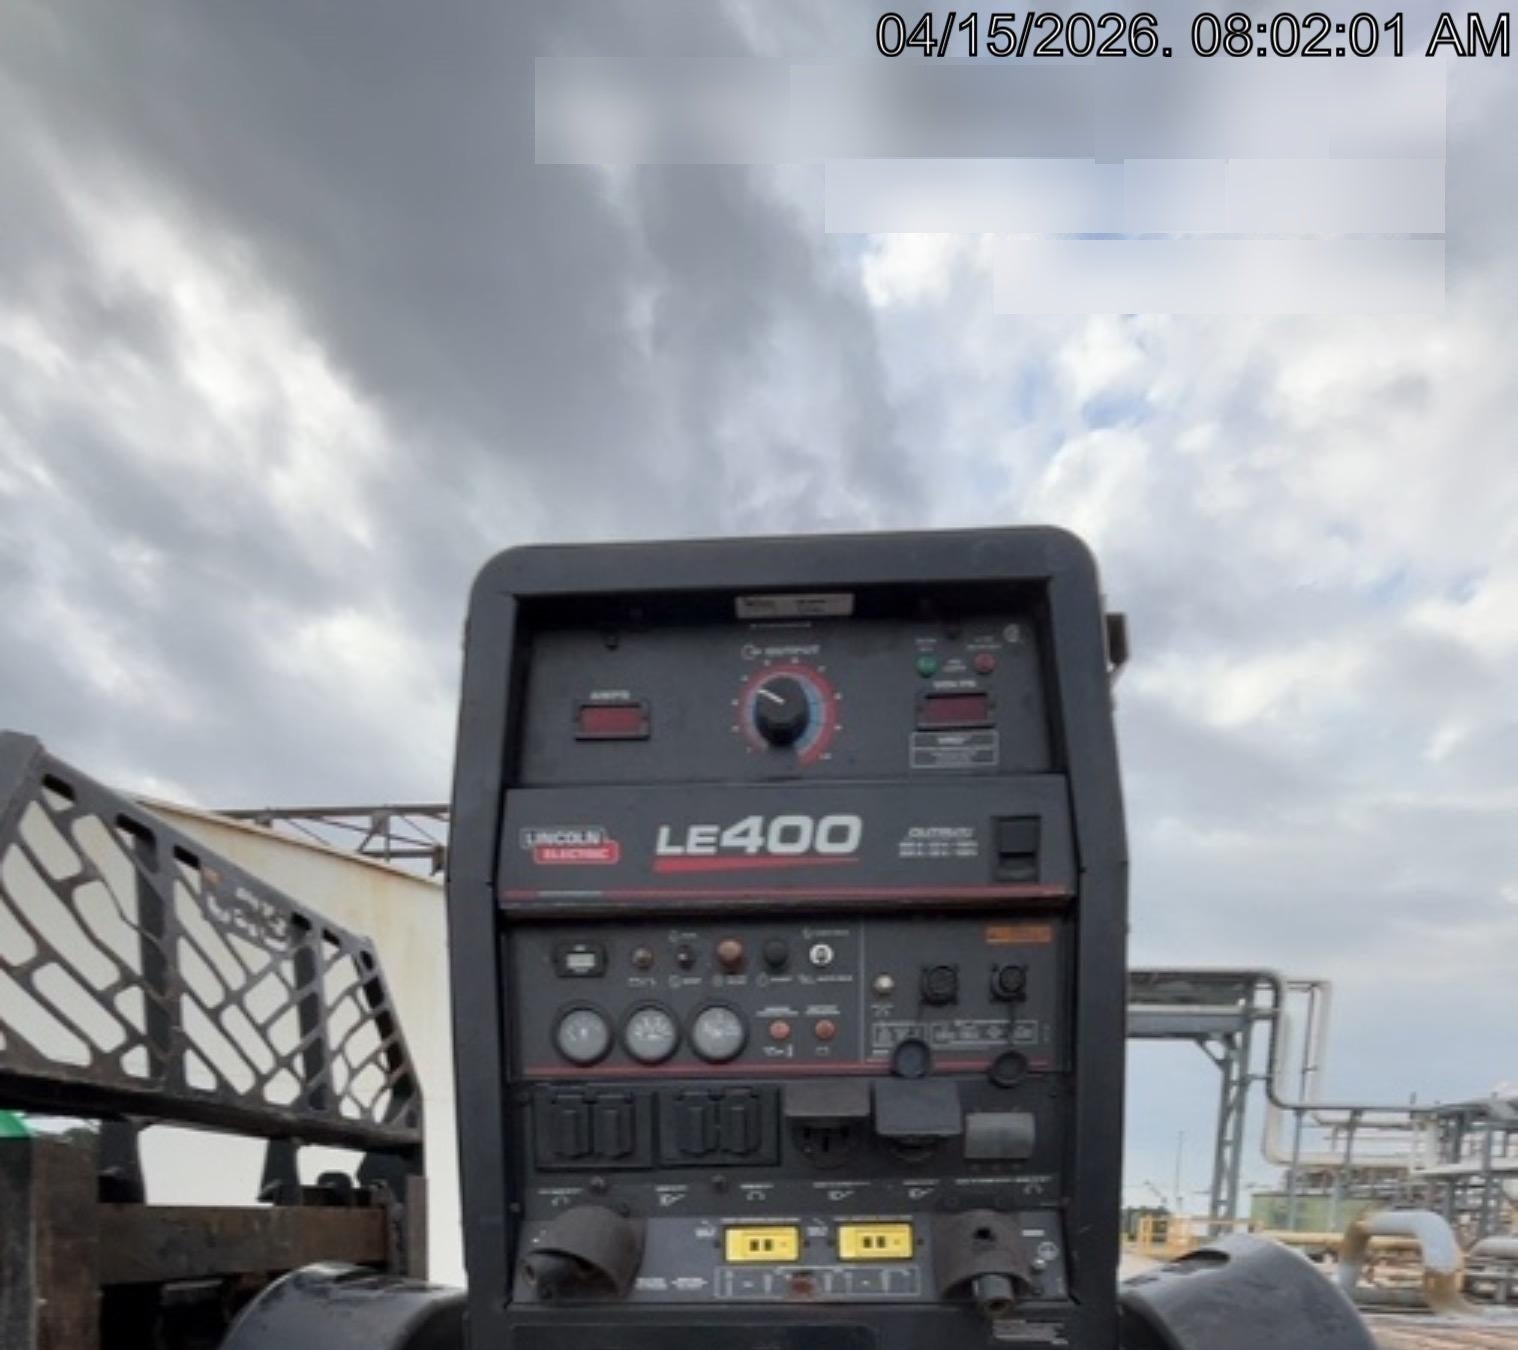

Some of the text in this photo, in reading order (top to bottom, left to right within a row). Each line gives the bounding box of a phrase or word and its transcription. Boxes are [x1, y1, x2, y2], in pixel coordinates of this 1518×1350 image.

[525, 829, 603, 845] LINCOLN
[656, 814, 862, 856] LE400
[541, 847, 610, 859] ELECTRIC
